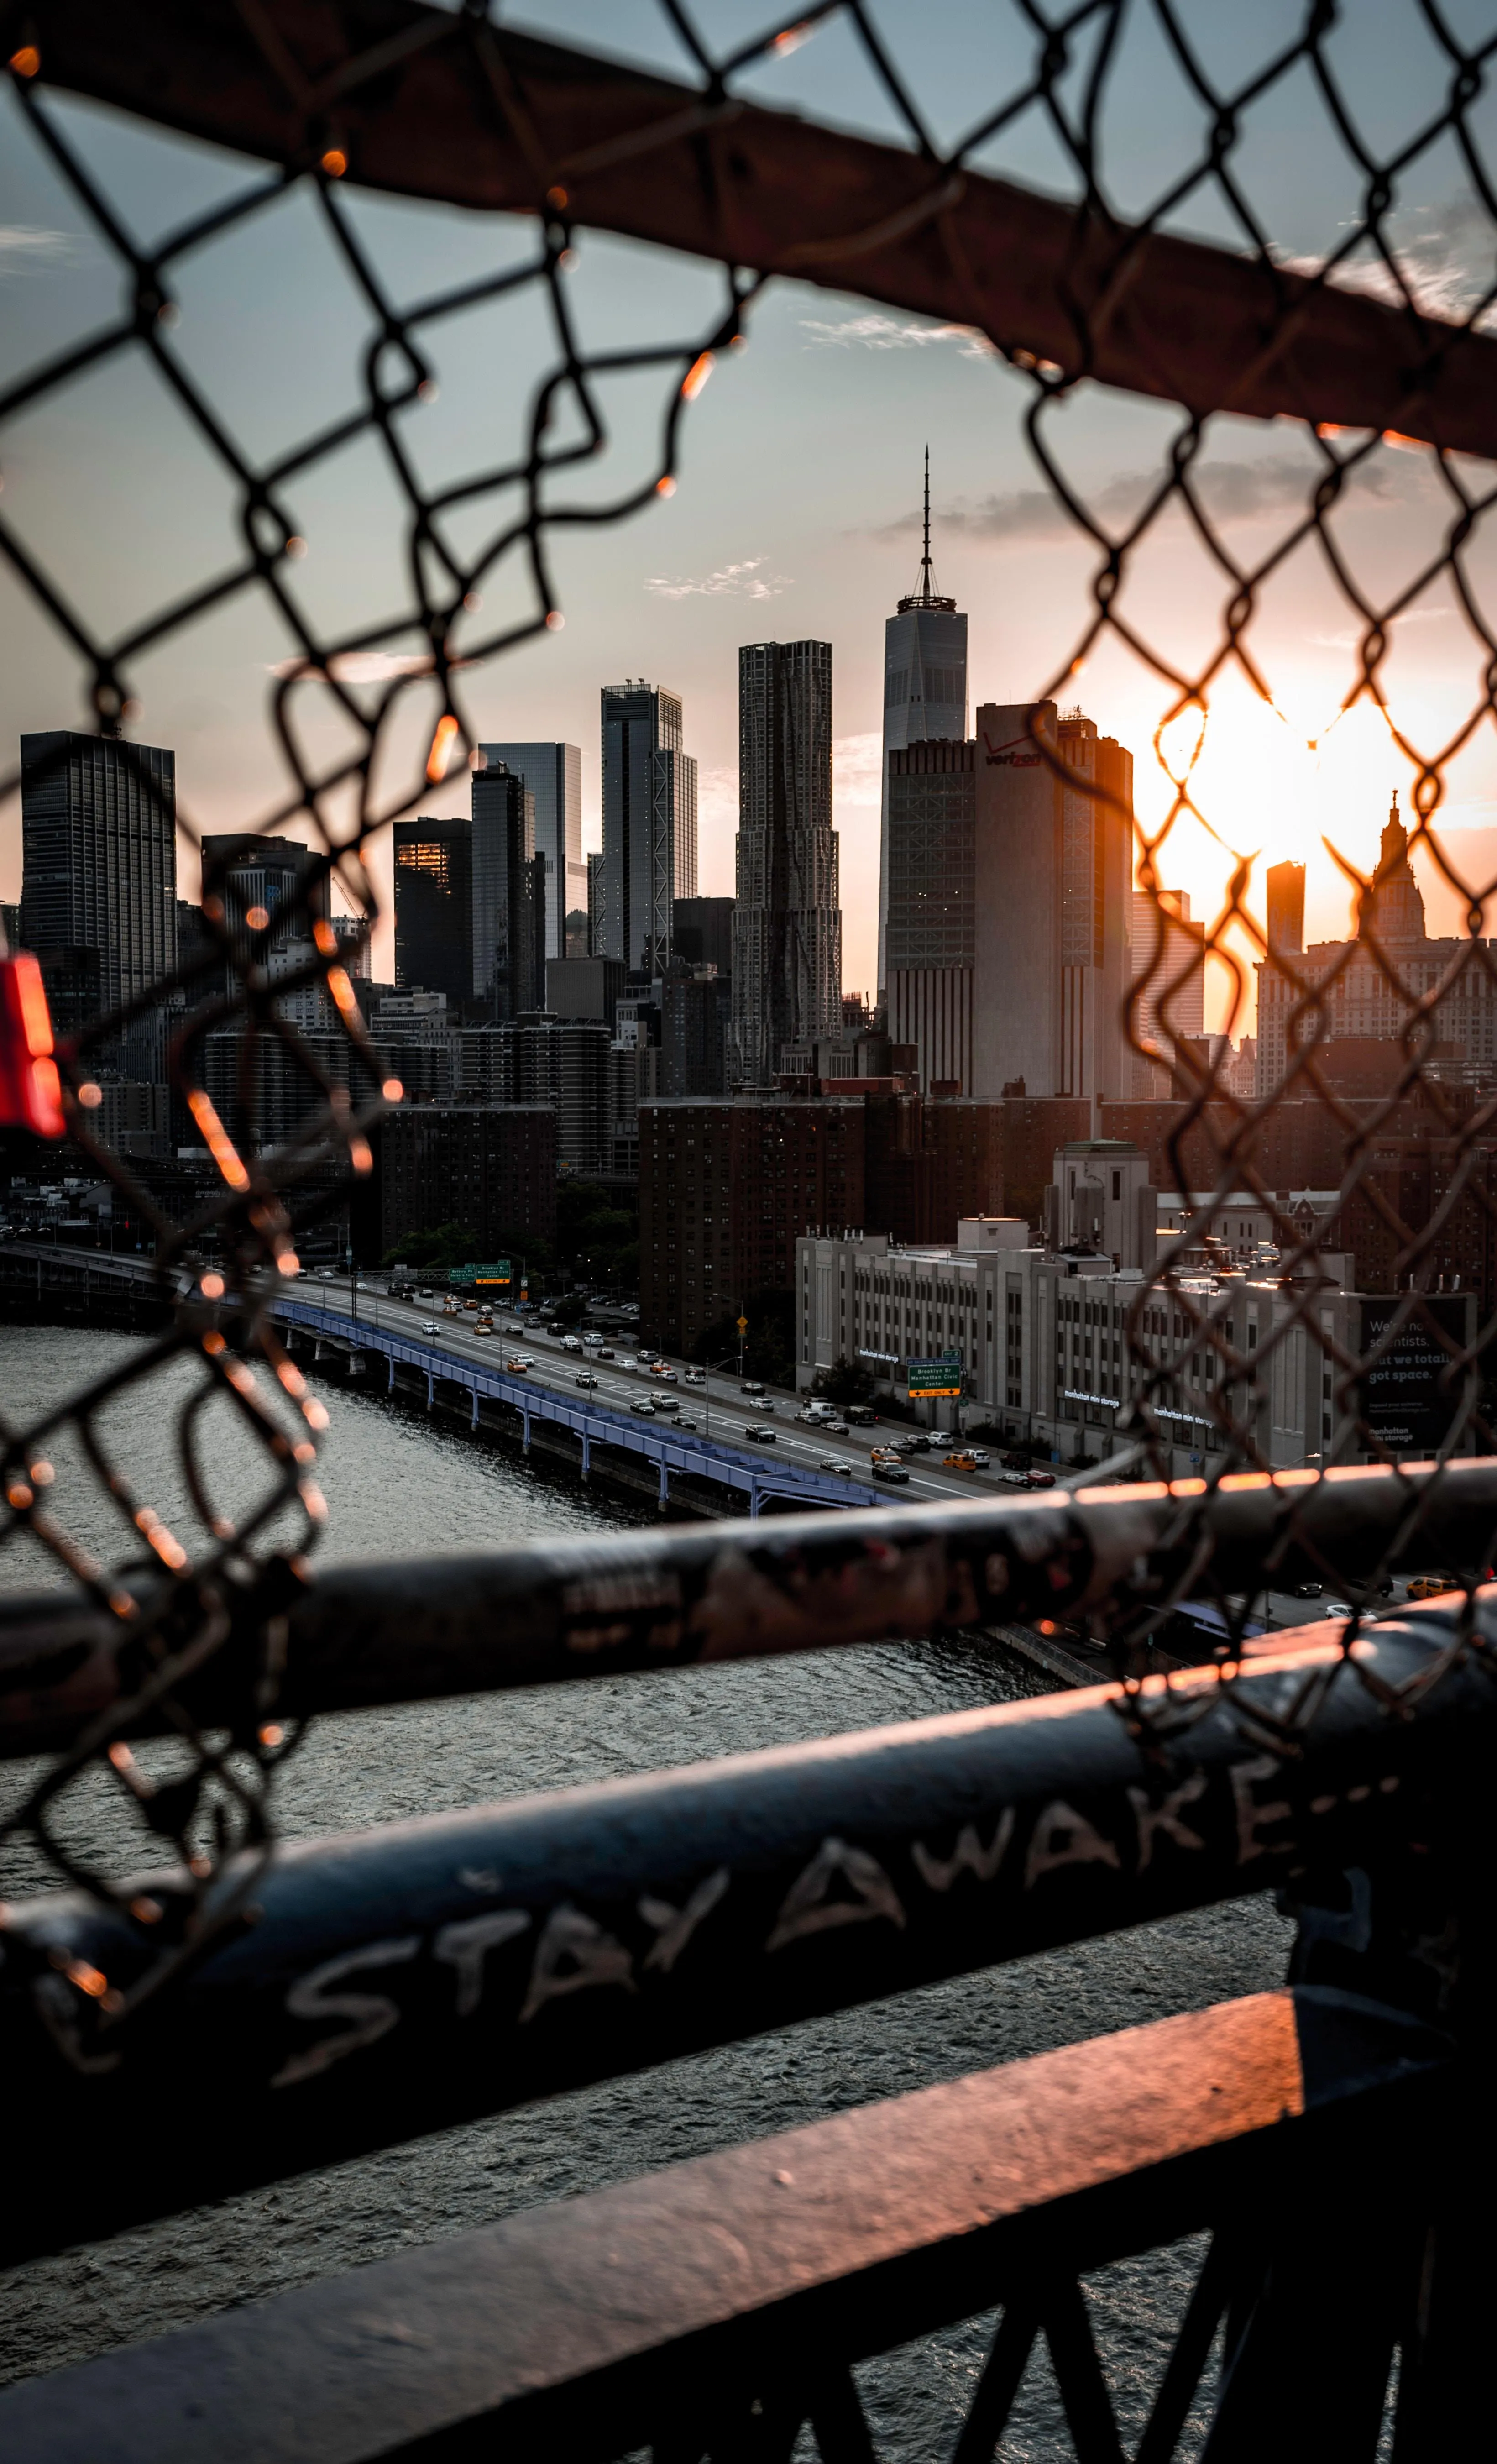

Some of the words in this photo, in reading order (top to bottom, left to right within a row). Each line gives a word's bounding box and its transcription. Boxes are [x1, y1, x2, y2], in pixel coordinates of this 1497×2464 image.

[986, 751, 1041, 767] verizon
[1409, 1321, 1429, 1332] no
[1393, 1356, 1412, 1365] we
[1414, 1353, 1454, 1365] totall
[1369, 1371, 1390, 1385] got
[1392, 1371, 1433, 1382] space.
[1064, 1388, 1090, 1401] manhattan
[1101, 1397, 1120, 1409] storage
[1154, 1406, 1182, 1420] manhattan
[1369, 1426, 1408, 1435] manhattan
[1384, 1434, 1414, 1442] storage
[268, 1865, 731, 2091] STAY
